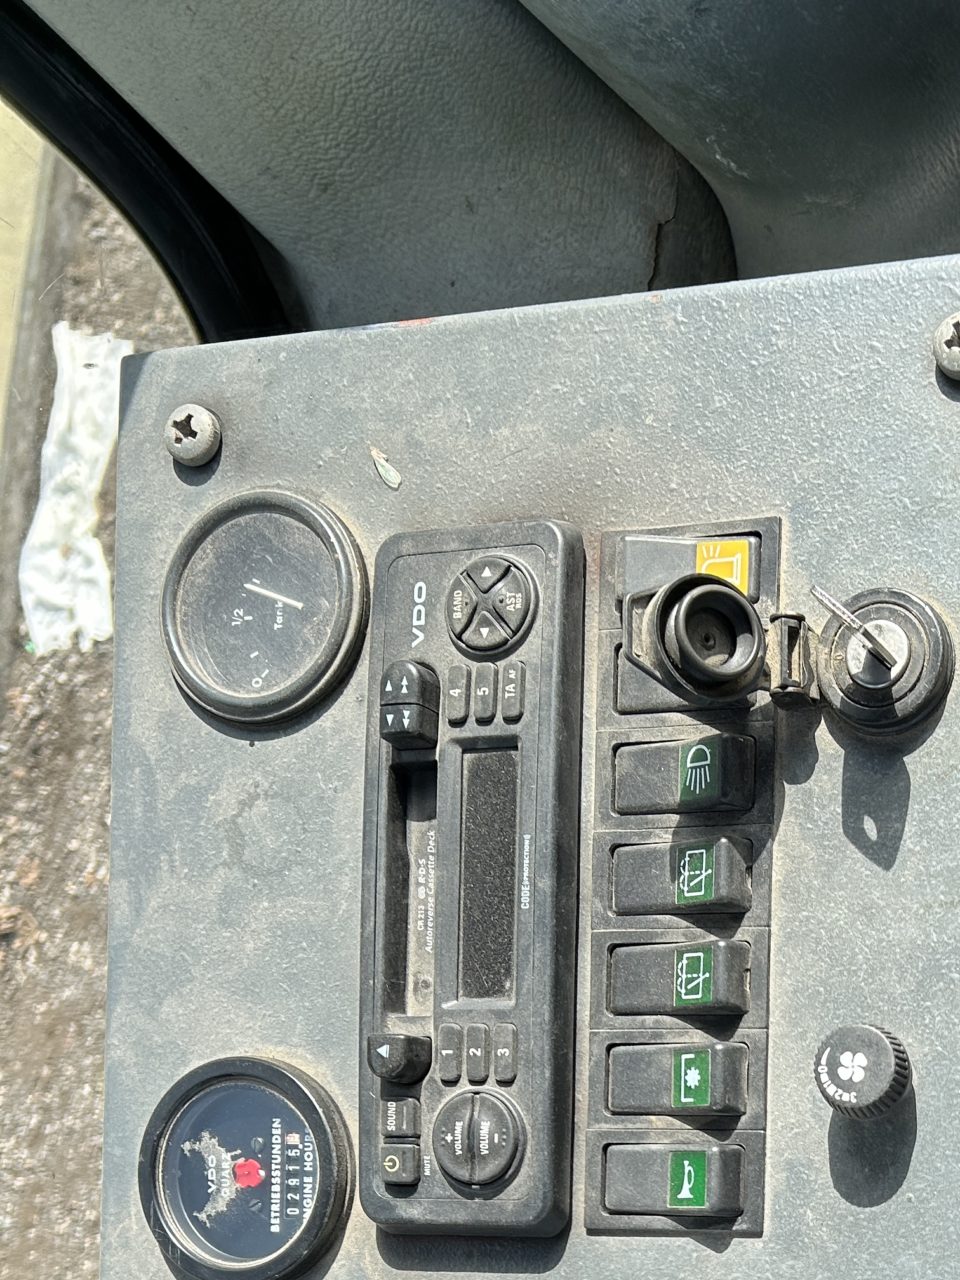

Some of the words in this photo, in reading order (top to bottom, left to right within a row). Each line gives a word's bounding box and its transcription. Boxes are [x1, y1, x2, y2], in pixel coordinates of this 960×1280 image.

[273, 600, 283, 630] Tank
[411, 581, 426, 648] VDO
[453, 589, 462, 619] BAND
[507, 592, 516, 611] AST
[230, 608, 244, 626] 1/2
[508, 669, 516, 679] AF
[449, 688, 461, 697] 4
[477, 687, 489, 695] 5
[505, 683, 515, 699] TA
[427, 830, 436, 854] Deck
[427, 855, 436, 895] Cassette
[520, 884, 530, 909] CODE
[425, 896, 434, 954] Autoreverse
[468, 1048, 481, 1057] 2
[497, 1048, 509, 1057] 3
[386, 1102, 396, 1131] SOUND
[455, 1121, 464, 1155] VOLUME
[480, 1121, 490, 1155] VOLUME
[208, 1155, 217, 1193] VDO
[221, 1153, 231, 1197] QUARZ
[271, 1118, 281, 1233] BETRIEBSSTUNDEN
